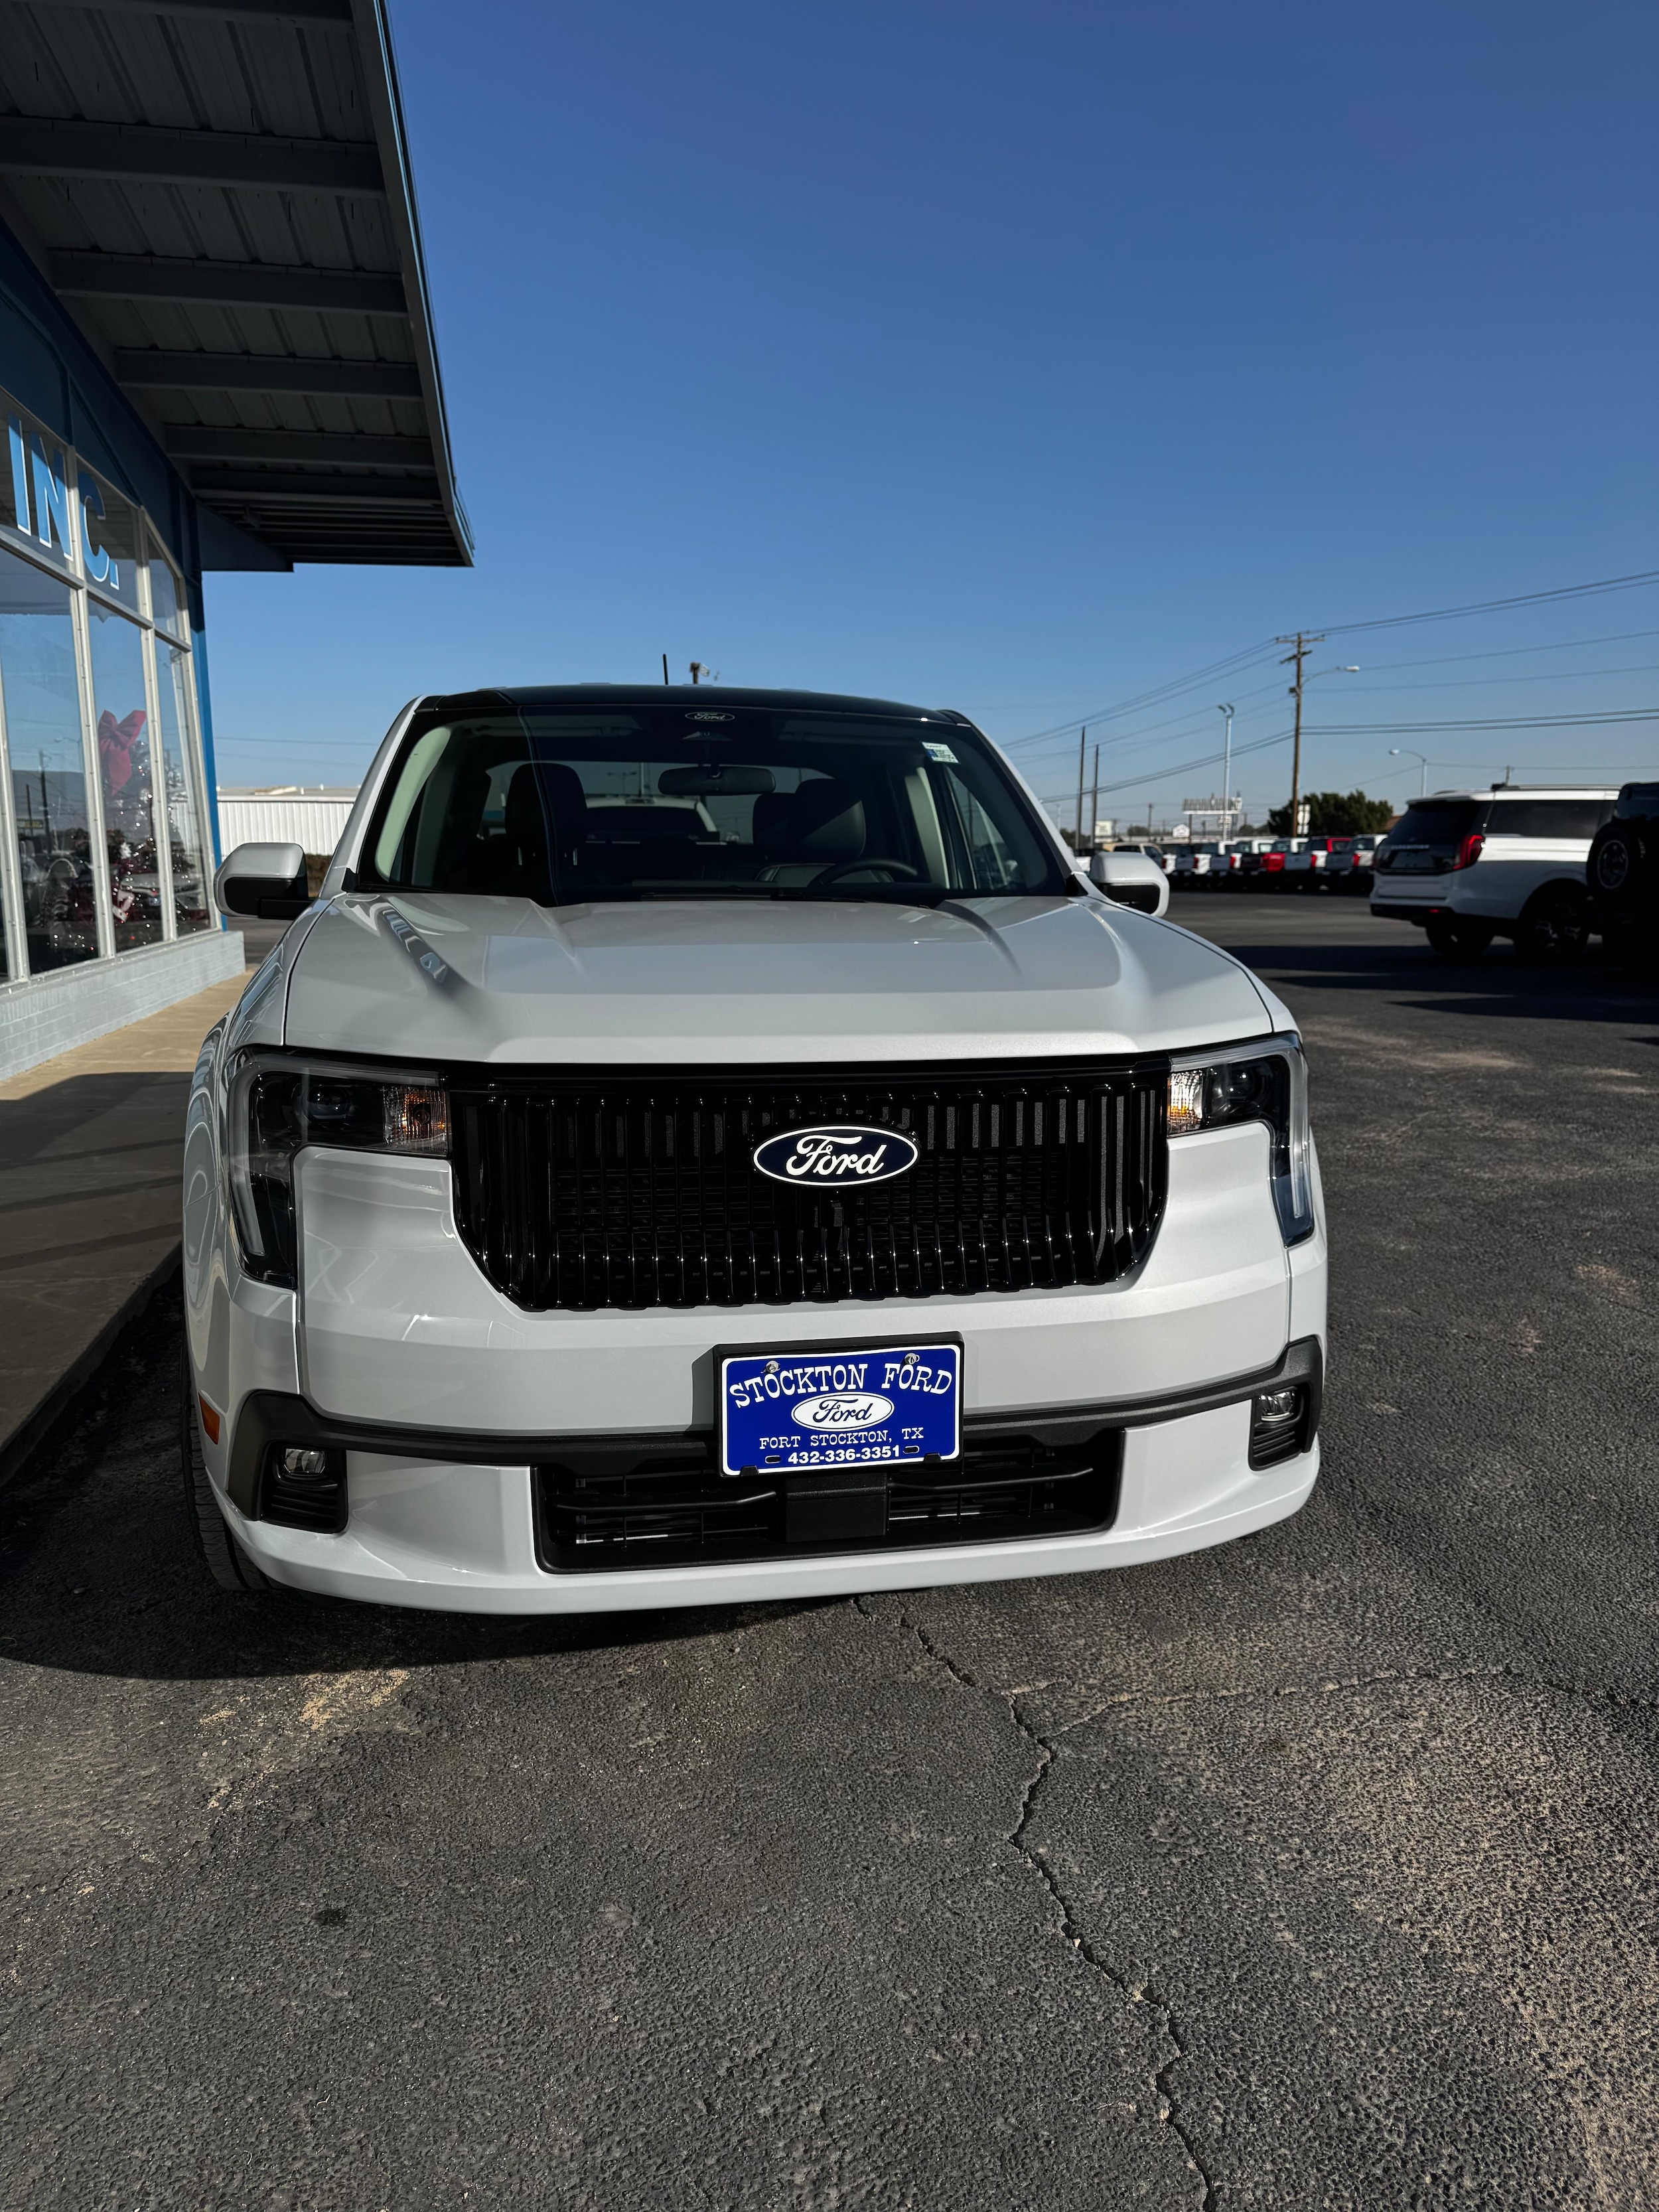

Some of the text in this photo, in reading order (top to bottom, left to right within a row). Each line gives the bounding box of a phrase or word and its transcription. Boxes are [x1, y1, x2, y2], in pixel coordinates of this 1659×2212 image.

[9, 413, 119, 590] INC.
[786, 1135, 887, 1176] Ford
[729, 1363, 952, 1408] STOCKTON FORD
[812, 1398, 874, 1424] Ford
[759, 1427, 924, 1449] FORT STOCKTON, TX
[788, 1444, 901, 1465] 432-336-3351
